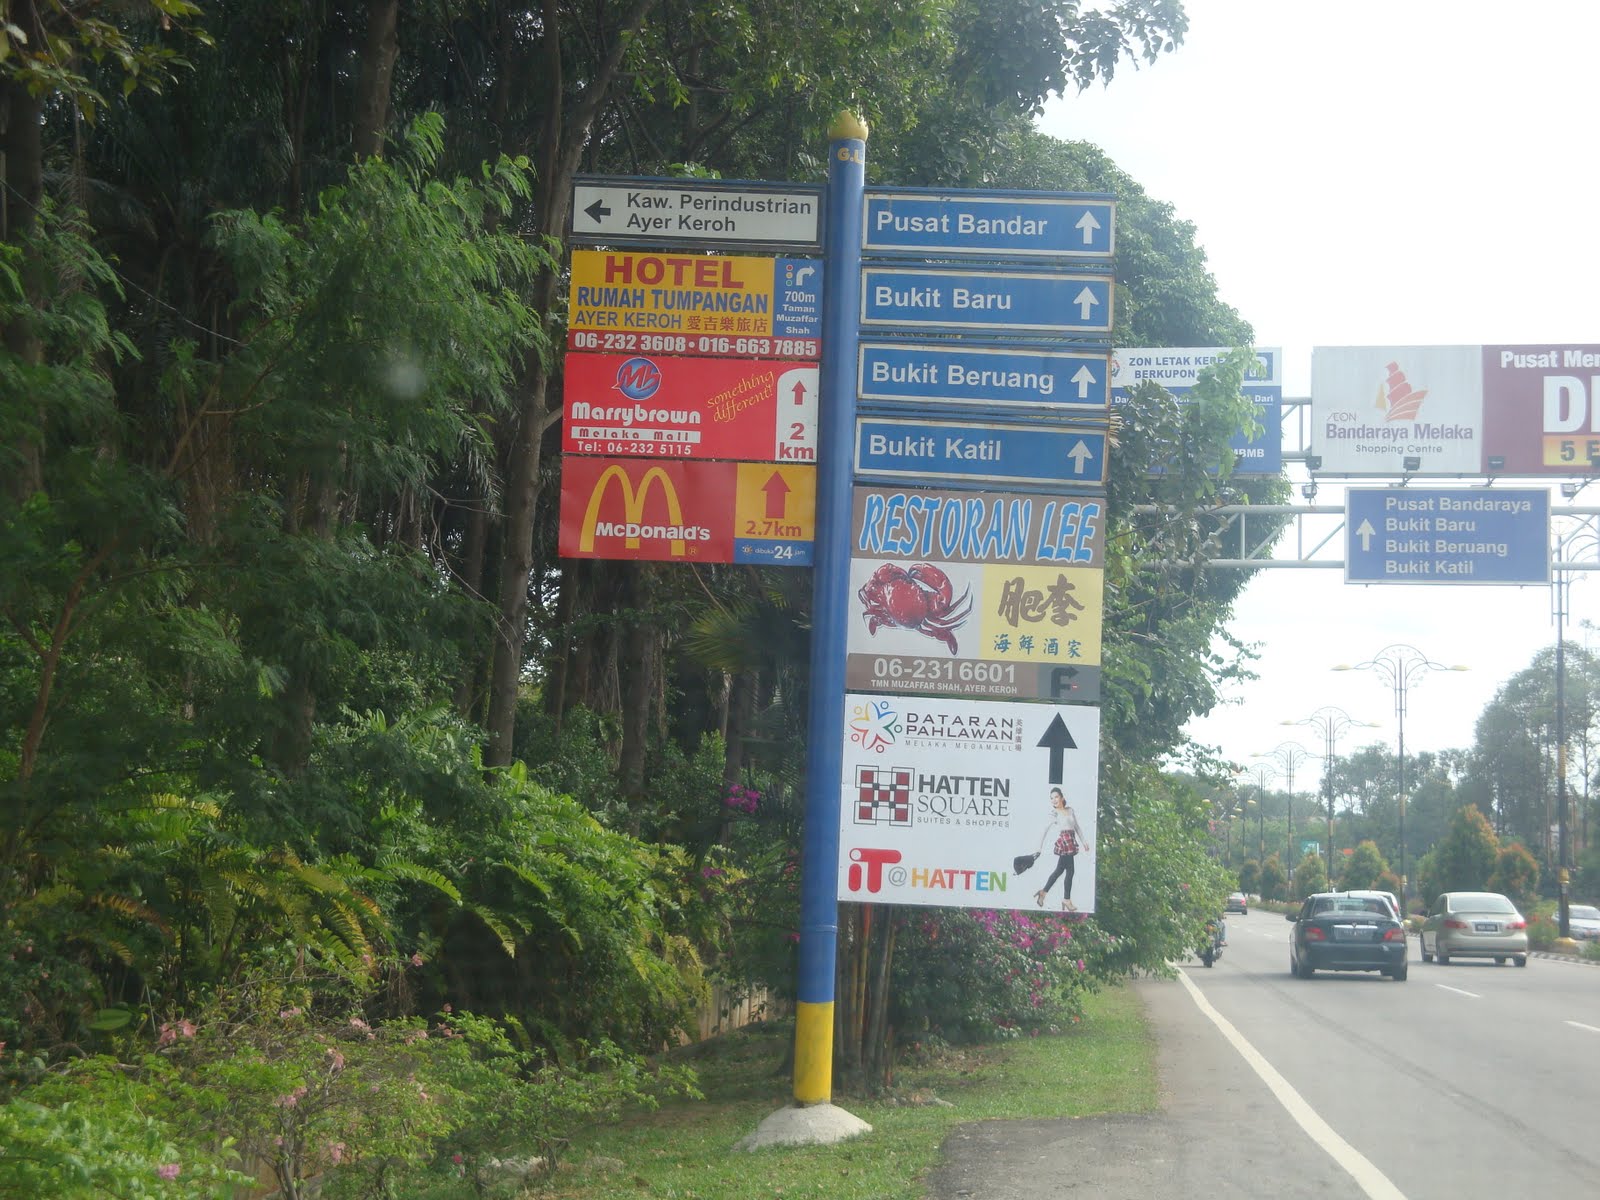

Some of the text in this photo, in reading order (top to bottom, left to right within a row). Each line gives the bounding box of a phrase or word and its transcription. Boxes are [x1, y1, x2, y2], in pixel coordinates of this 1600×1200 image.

[627, 192, 811, 214] Kaw. Perindustrian
[627, 213, 736, 232] Ayer Keroh
[877, 211, 1047, 236] Pusat Bandar
[605, 255, 744, 288] HOTEL
[578, 287, 768, 313] RUMAH TUMPANGAN
[784, 291, 815, 303] 700m
[875, 286, 1011, 310] Bukit Baru
[782, 304, 815, 313] Taman
[575, 310, 681, 329] AYER KEROH
[776, 314, 818, 323] Muzaffar
[786, 326, 810, 334] Shah
[575, 332, 816, 356] 06-232 3608 016-663 7885
[1129, 357, 1152, 366] ZON
[1156, 357, 1190, 365] LETAK
[1501, 351, 1558, 369] Pusat
[872, 361, 1054, 394] Bukit Beruang
[1135, 369, 1195, 378] BERKUPON
[707, 370, 775, 408] something
[713, 384, 773, 422] different!
[571, 402, 700, 425] Marrybrown
[579, 427, 689, 441] Melaka Mall
[790, 422, 805, 440] 2
[1326, 424, 1473, 442] Bandaraya Melaka
[578, 441, 692, 455] Tel: 06-232 5115
[779, 443, 814, 459] km
[869, 434, 1001, 460] Bukit Katil
[1356, 444, 1442, 455] Shopping Centre
[1561, 441, 1575, 461] 5
[1385, 498, 1531, 514] Pusat Bandaraya
[596, 522, 711, 541] McDonald's
[745, 521, 802, 537] 2.7km
[859, 493, 1100, 564] RESTORAN LEE
[1385, 518, 1476, 531] Bukit Baru
[774, 546, 792, 559] 24
[1385, 540, 1508, 556] Bukit Beruang
[1385, 561, 1473, 574] Bukit Katil
[993, 634, 1082, 657] 海鮮酒家
[891, 681, 935, 689] MUZAFFAR
[937, 683, 962, 692] SHAH,
[964, 684, 985, 692] AYER
[989, 685, 1017, 694] KEROH
[907, 713, 1013, 729] DATARAN
[906, 725, 1013, 740] PAHLAWAN
[905, 740, 1012, 752] MELAKA MEGAMALL
[918, 774, 1010, 797] HATTEN
[917, 796, 1009, 818] SQUARE
[966, 819, 1010, 827] SHOPPES
